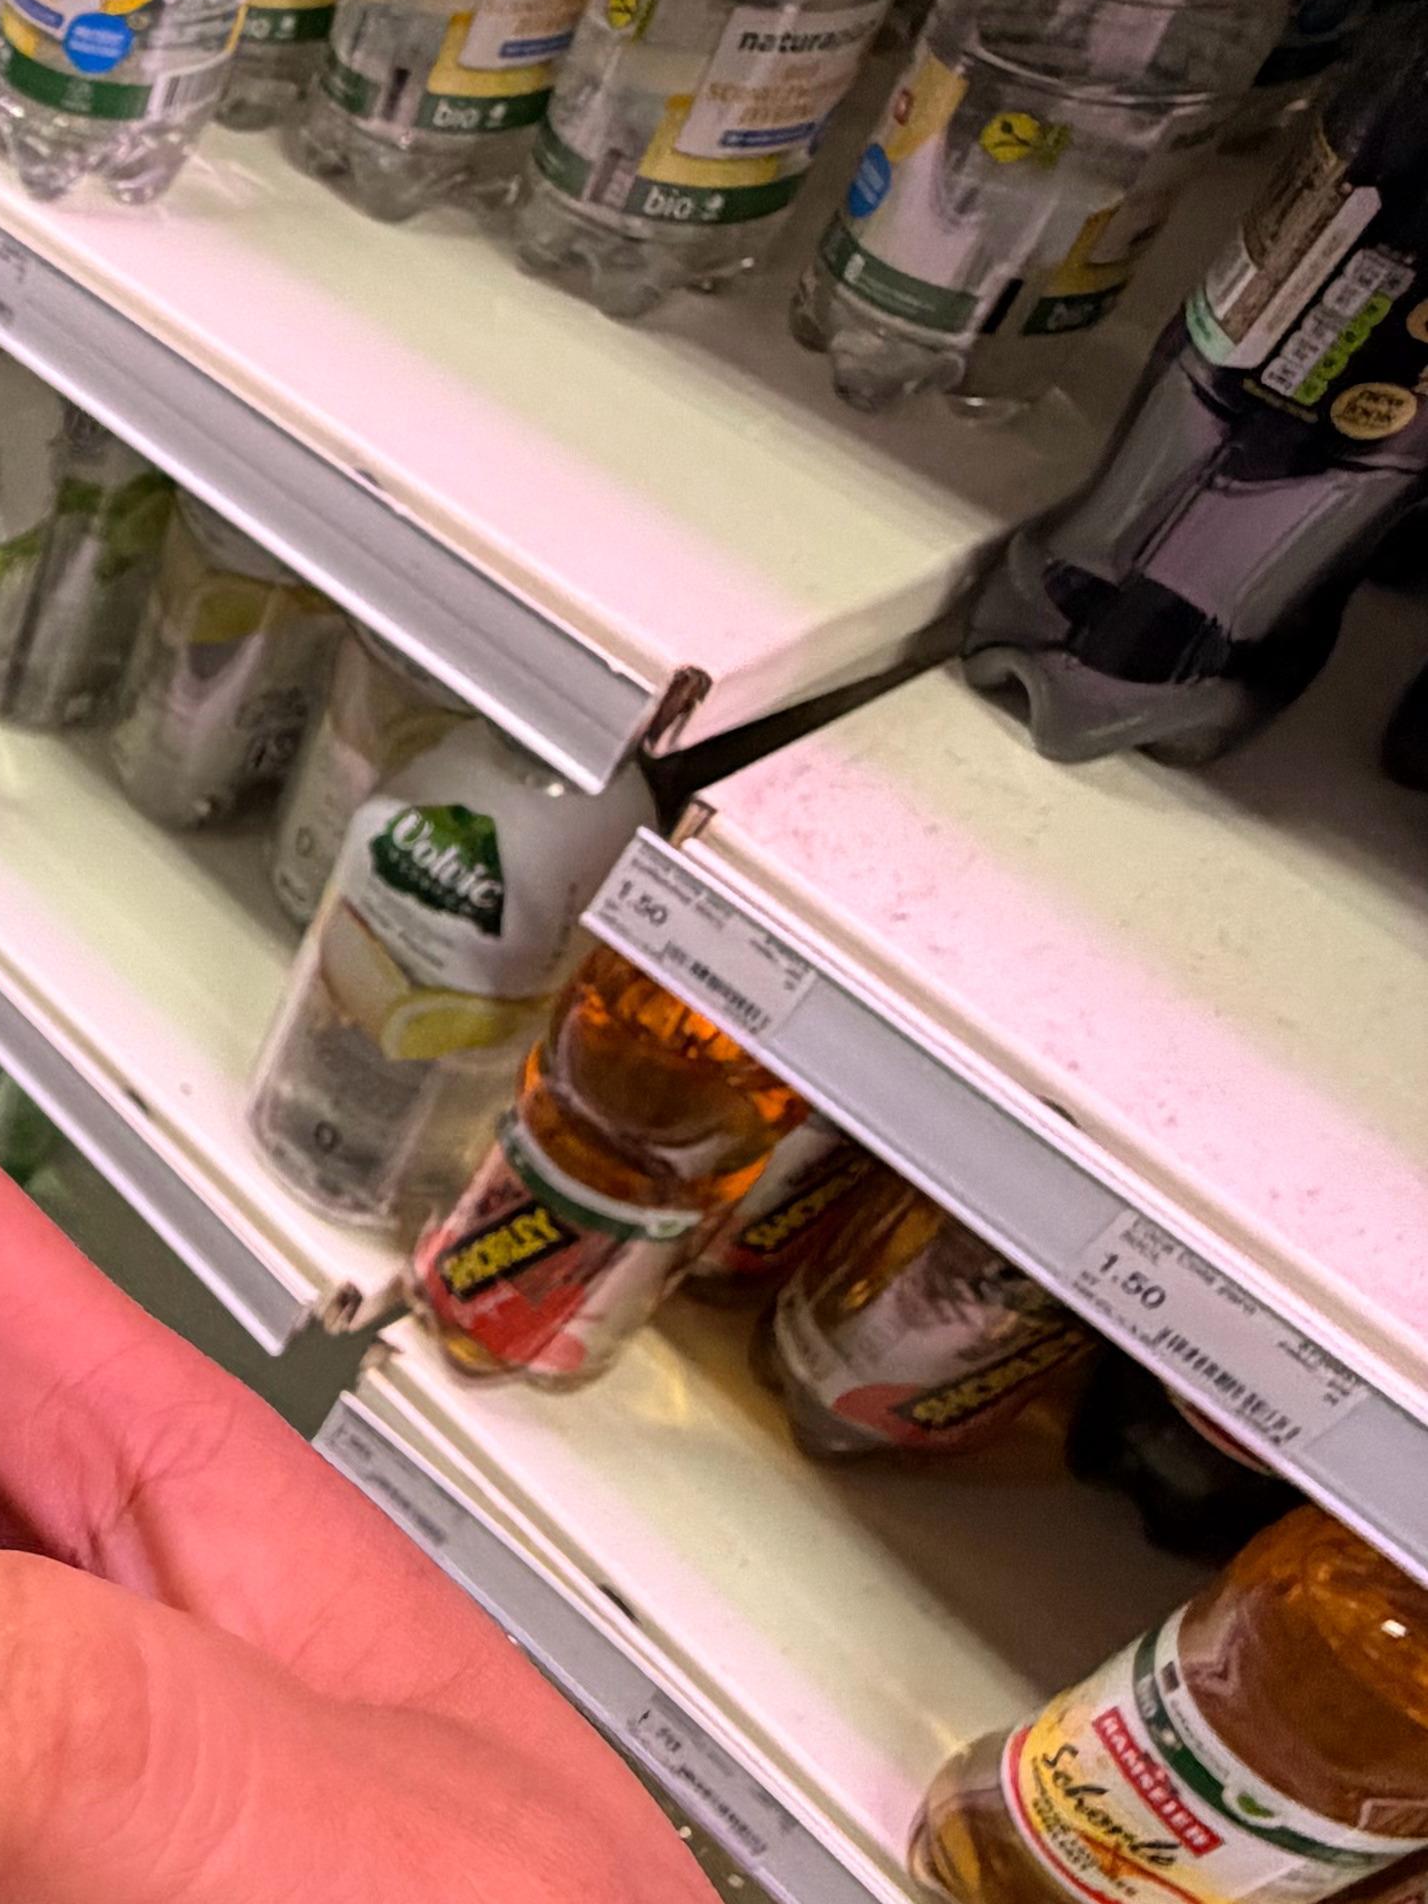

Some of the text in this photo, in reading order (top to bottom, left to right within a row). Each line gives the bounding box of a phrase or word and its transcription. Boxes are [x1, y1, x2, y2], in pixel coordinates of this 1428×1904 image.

[643, 183, 694, 221] bio
[391, 808, 502, 909] Volvic
[1099, 1252, 1167, 1310] 1.50
